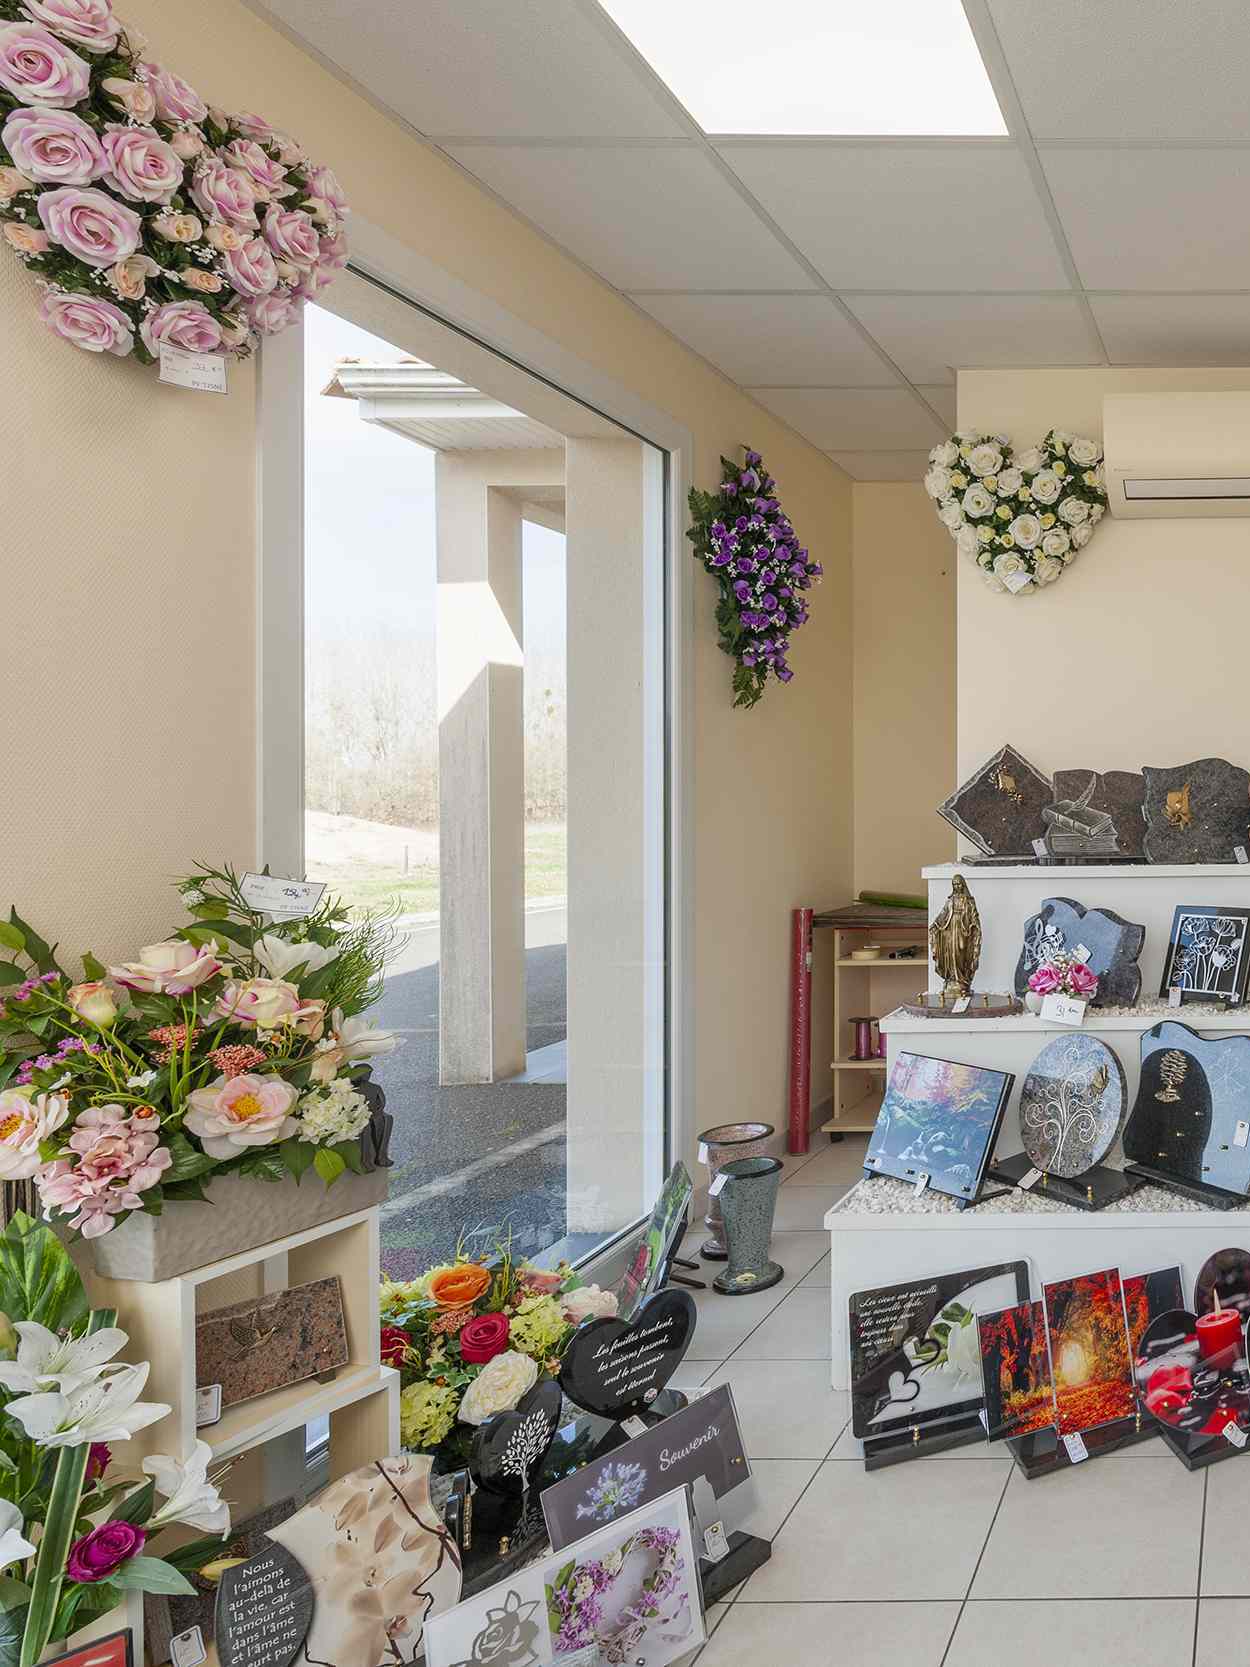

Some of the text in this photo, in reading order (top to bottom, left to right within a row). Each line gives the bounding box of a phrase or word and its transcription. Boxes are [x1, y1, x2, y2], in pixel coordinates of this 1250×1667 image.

[592, 1343, 609, 1359] Les
[608, 1331, 639, 1355] feuilles
[597, 1361, 609, 1373] les
[609, 1350, 638, 1368] saisons
[603, 1352, 664, 1386] seul le souvenir
[615, 1384, 628, 1397] est
[658, 1424, 721, 1471] Souvenir
[233, 1567, 285, 1596] l'aimons
[242, 1558, 275, 1579] Nous
[228, 1577, 291, 1612] au-delà de
[233, 1611, 245, 1623] la
[271, 1591, 289, 1605] car
[229, 1600, 296, 1639] l'amour est
[231, 1615, 295, 1651] dans l'âme
[231, 1628, 297, 1665] et l'âme ne
[274, 1642, 297, 1660] pas.
